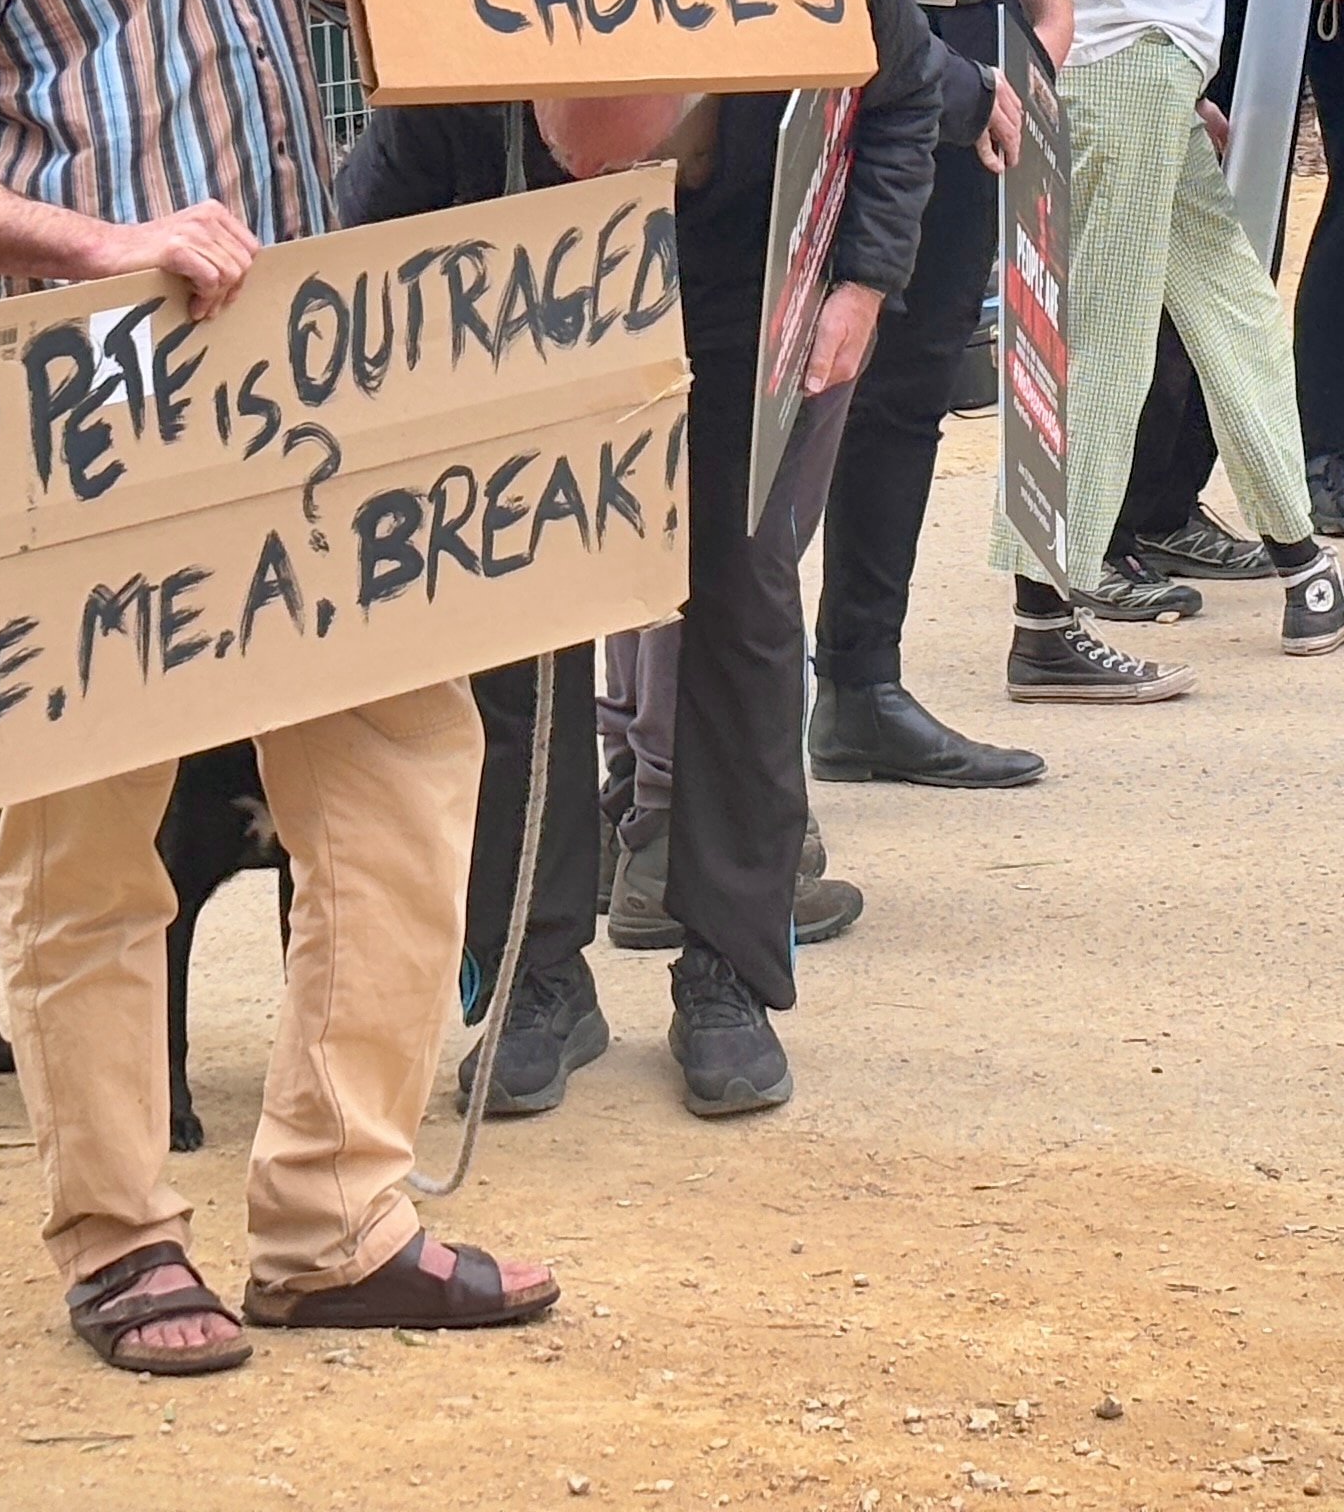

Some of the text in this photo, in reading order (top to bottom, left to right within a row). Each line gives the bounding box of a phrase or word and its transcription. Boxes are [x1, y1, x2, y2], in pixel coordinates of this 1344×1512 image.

[1017, 223, 1044, 307] PEOPLE
[22, 296, 208, 501] PETE
[215, 360, 282, 460] IS
[288, 197, 679, 408] OUTRAGED
[283, 422, 342, 553] ?
[353, 413, 689, 614] BREAK!
